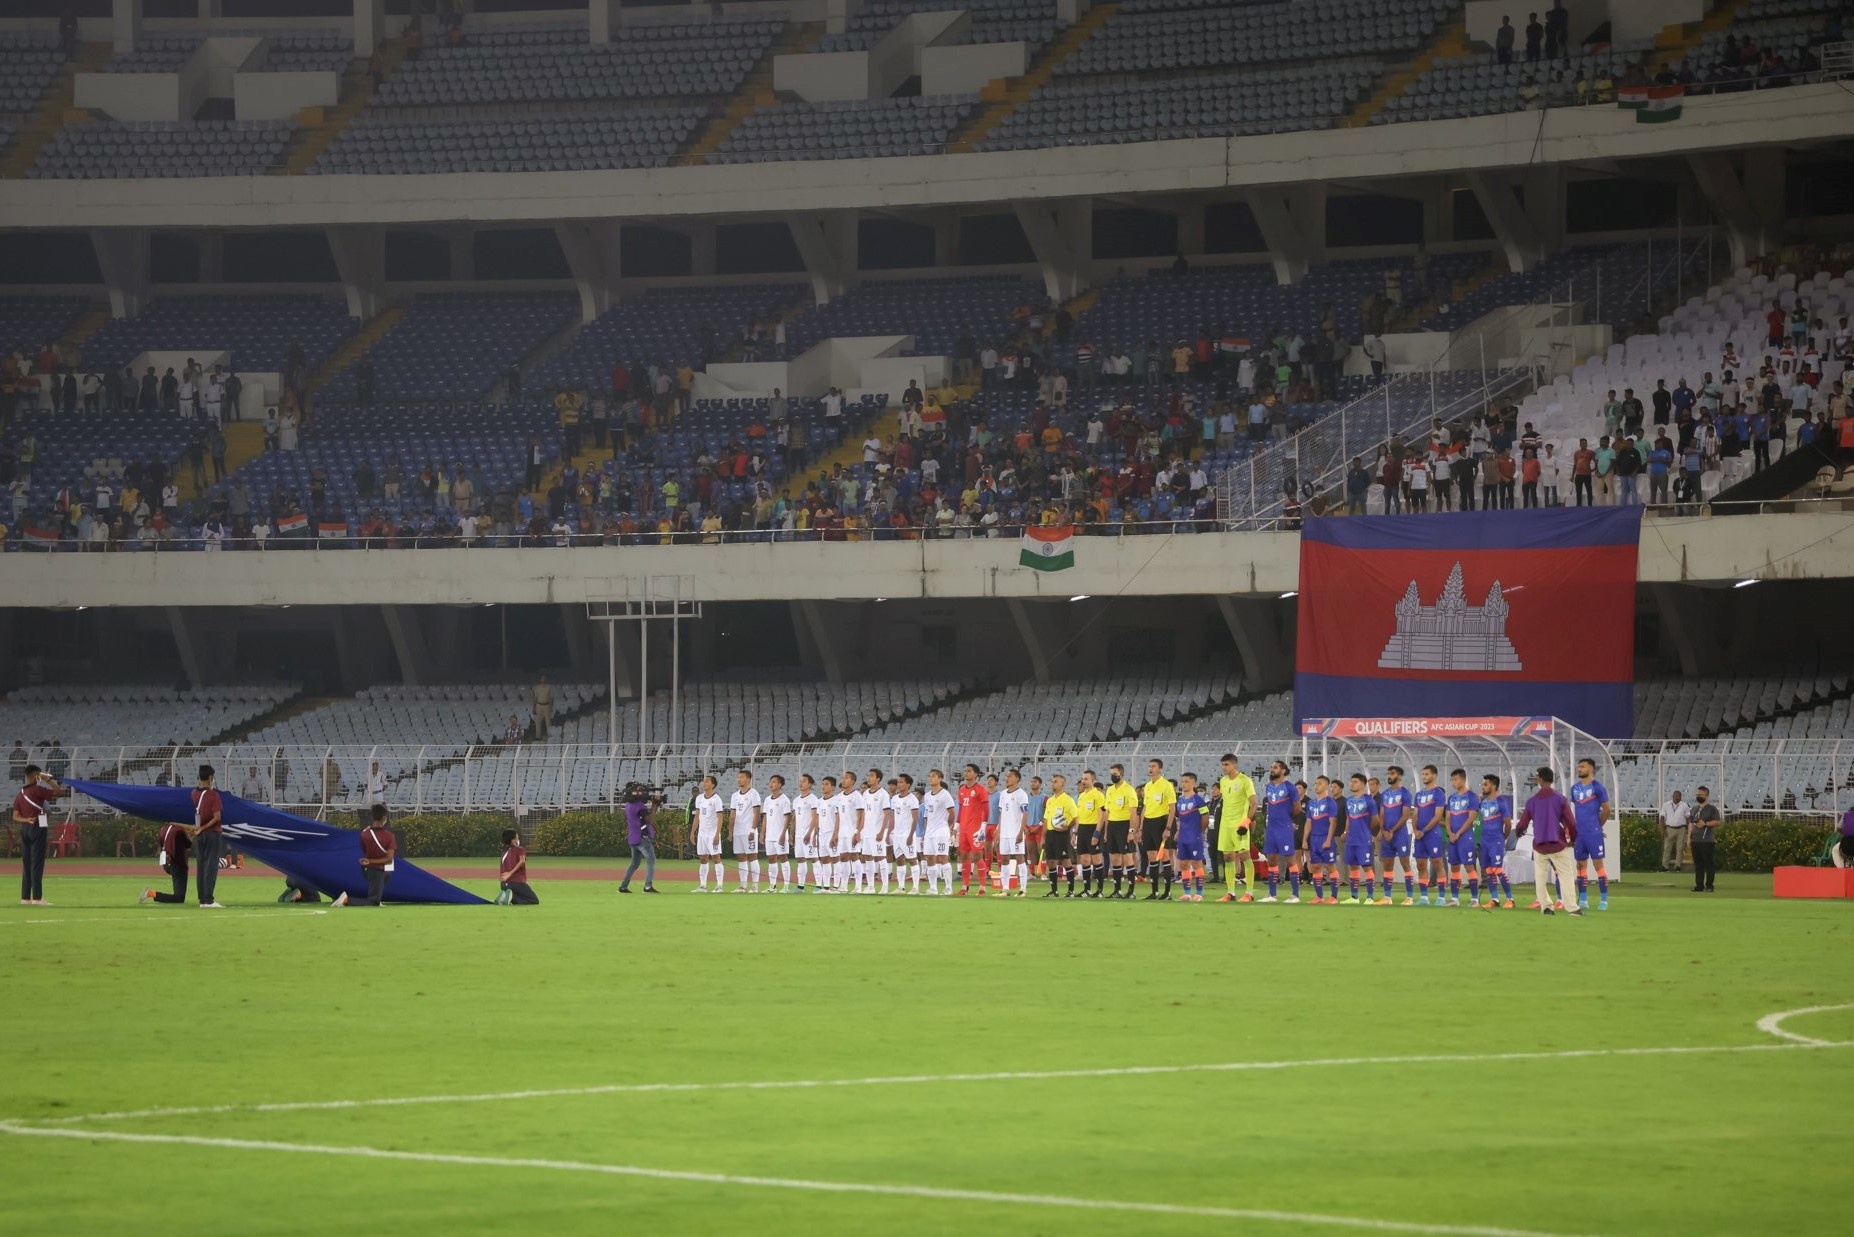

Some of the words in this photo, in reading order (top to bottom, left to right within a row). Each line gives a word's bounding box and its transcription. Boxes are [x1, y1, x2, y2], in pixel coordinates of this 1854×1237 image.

[1355, 721, 1428, 734] QUALIFIERS
[1445, 723, 1464, 731] ASIAN
[1465, 723, 1477, 731] CUP
[963, 797, 970, 806] 22
[748, 842, 756, 850] 23
[808, 846, 813, 854] 2
[938, 843, 945, 851] 20
